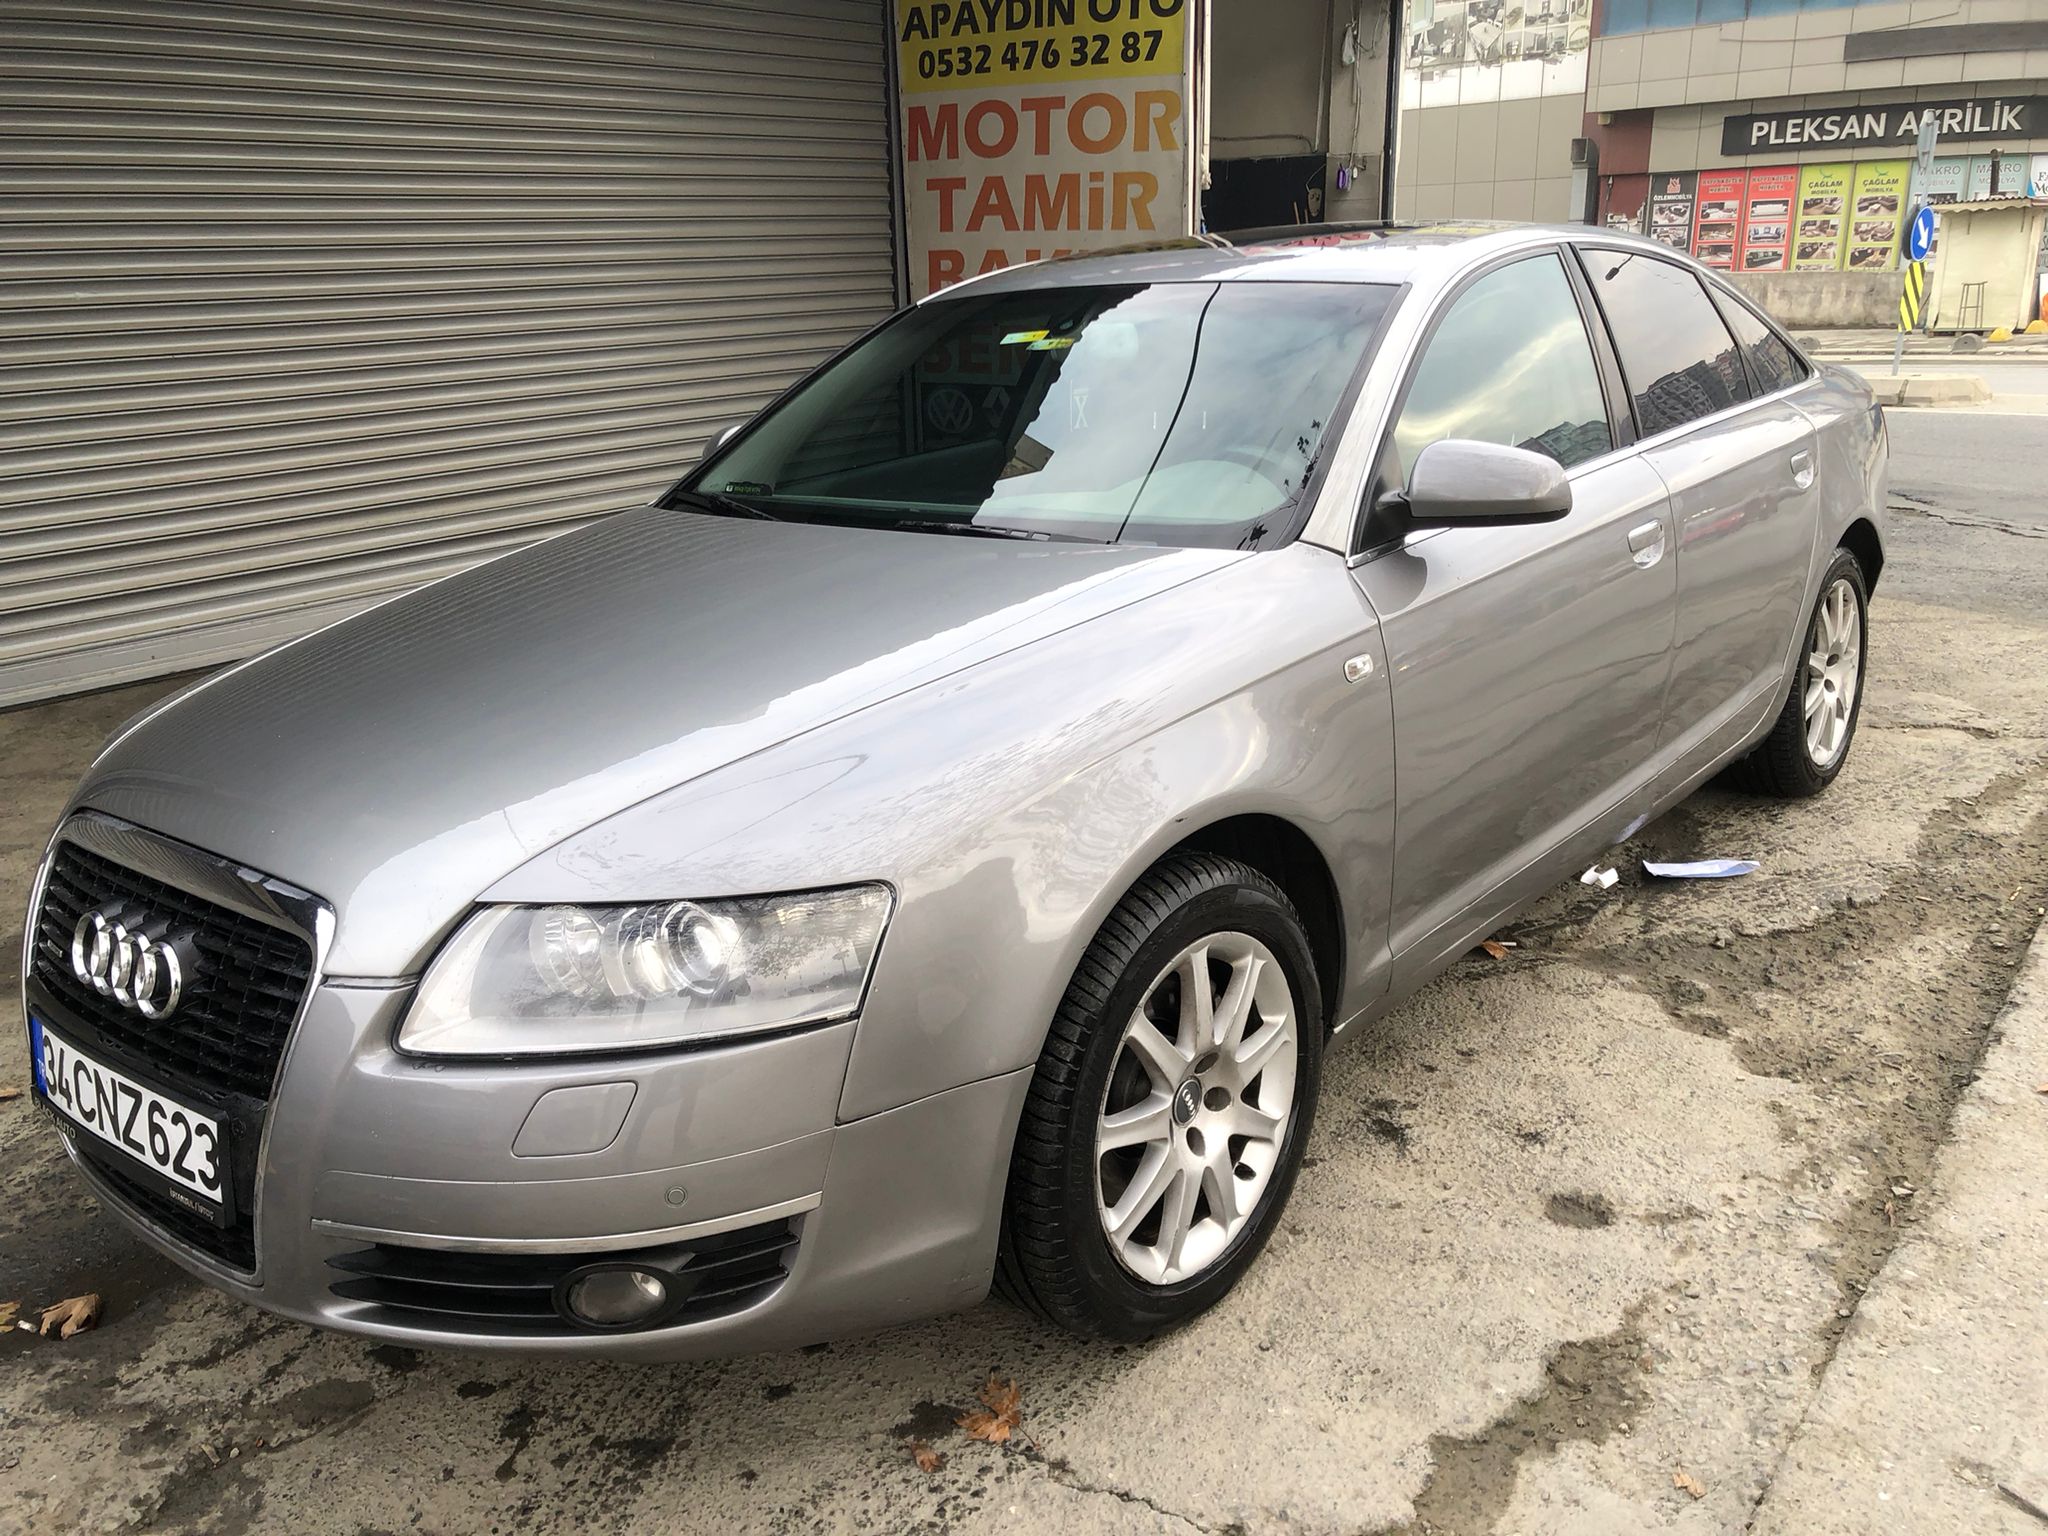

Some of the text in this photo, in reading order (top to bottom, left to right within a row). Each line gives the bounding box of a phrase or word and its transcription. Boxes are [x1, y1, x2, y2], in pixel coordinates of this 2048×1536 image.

[918, 30, 1163, 79] 0532 476 32 87
[908, 90, 1182, 162] MOTOR
[1750, 112, 1887, 146] PLEKSAN
[1918, 165, 1962, 176] MKRO
[42, 1034, 220, 1192] 34CNZ623
